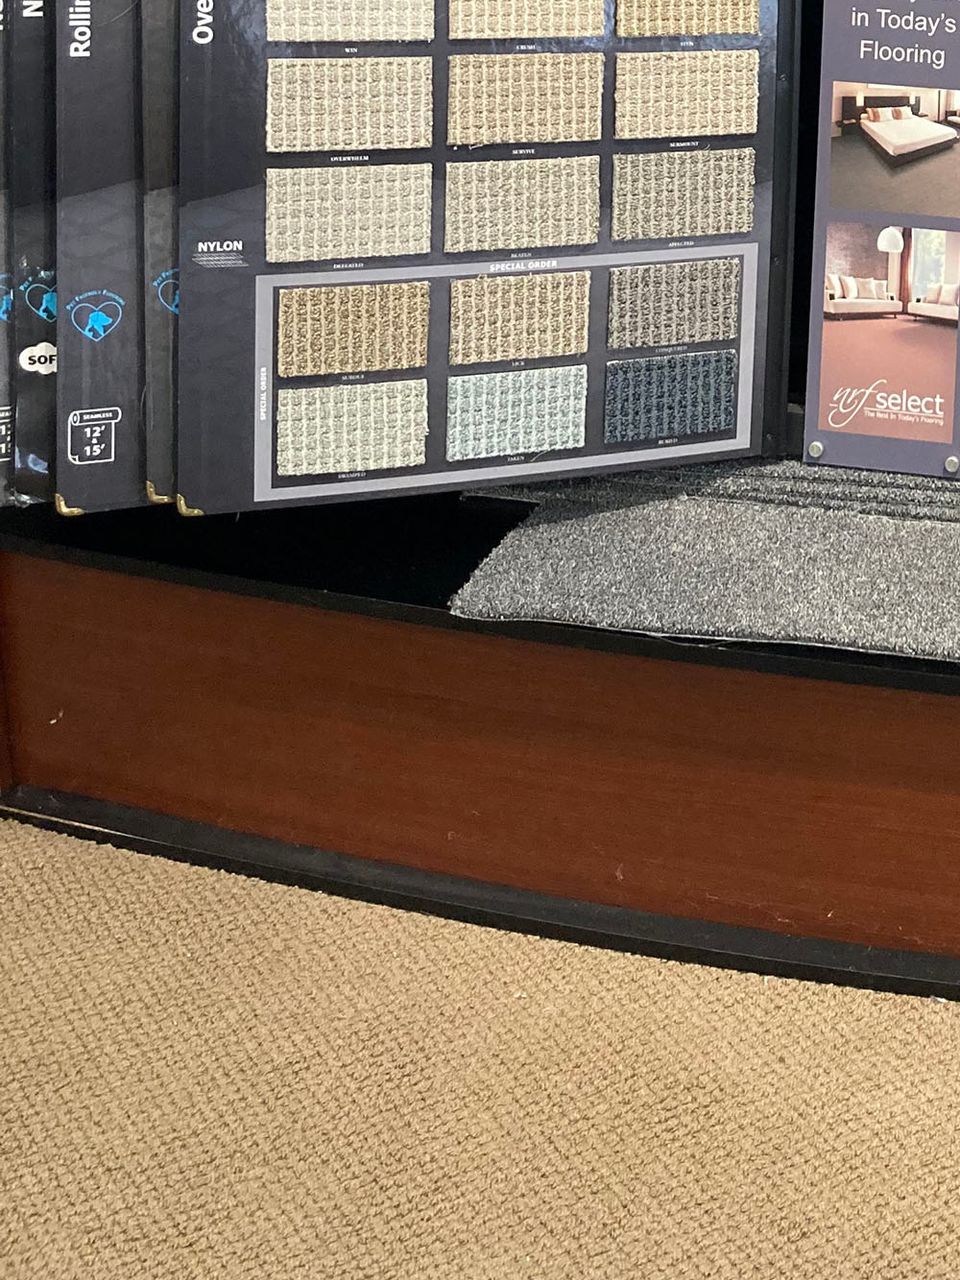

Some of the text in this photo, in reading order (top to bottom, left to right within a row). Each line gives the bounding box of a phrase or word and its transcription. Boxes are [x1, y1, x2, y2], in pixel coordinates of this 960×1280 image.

[851, 7, 957, 36] in Today's
[859, 39, 946, 69] Flooring
[197, 240, 243, 252] NYLON
[489, 260, 558, 272] SPECIAL ORDER
[28, 354, 57, 366] SOF
[828, 379, 945, 428] nrf select
[84, 425, 105, 438] 12'
[84, 443, 105, 456] 15'
